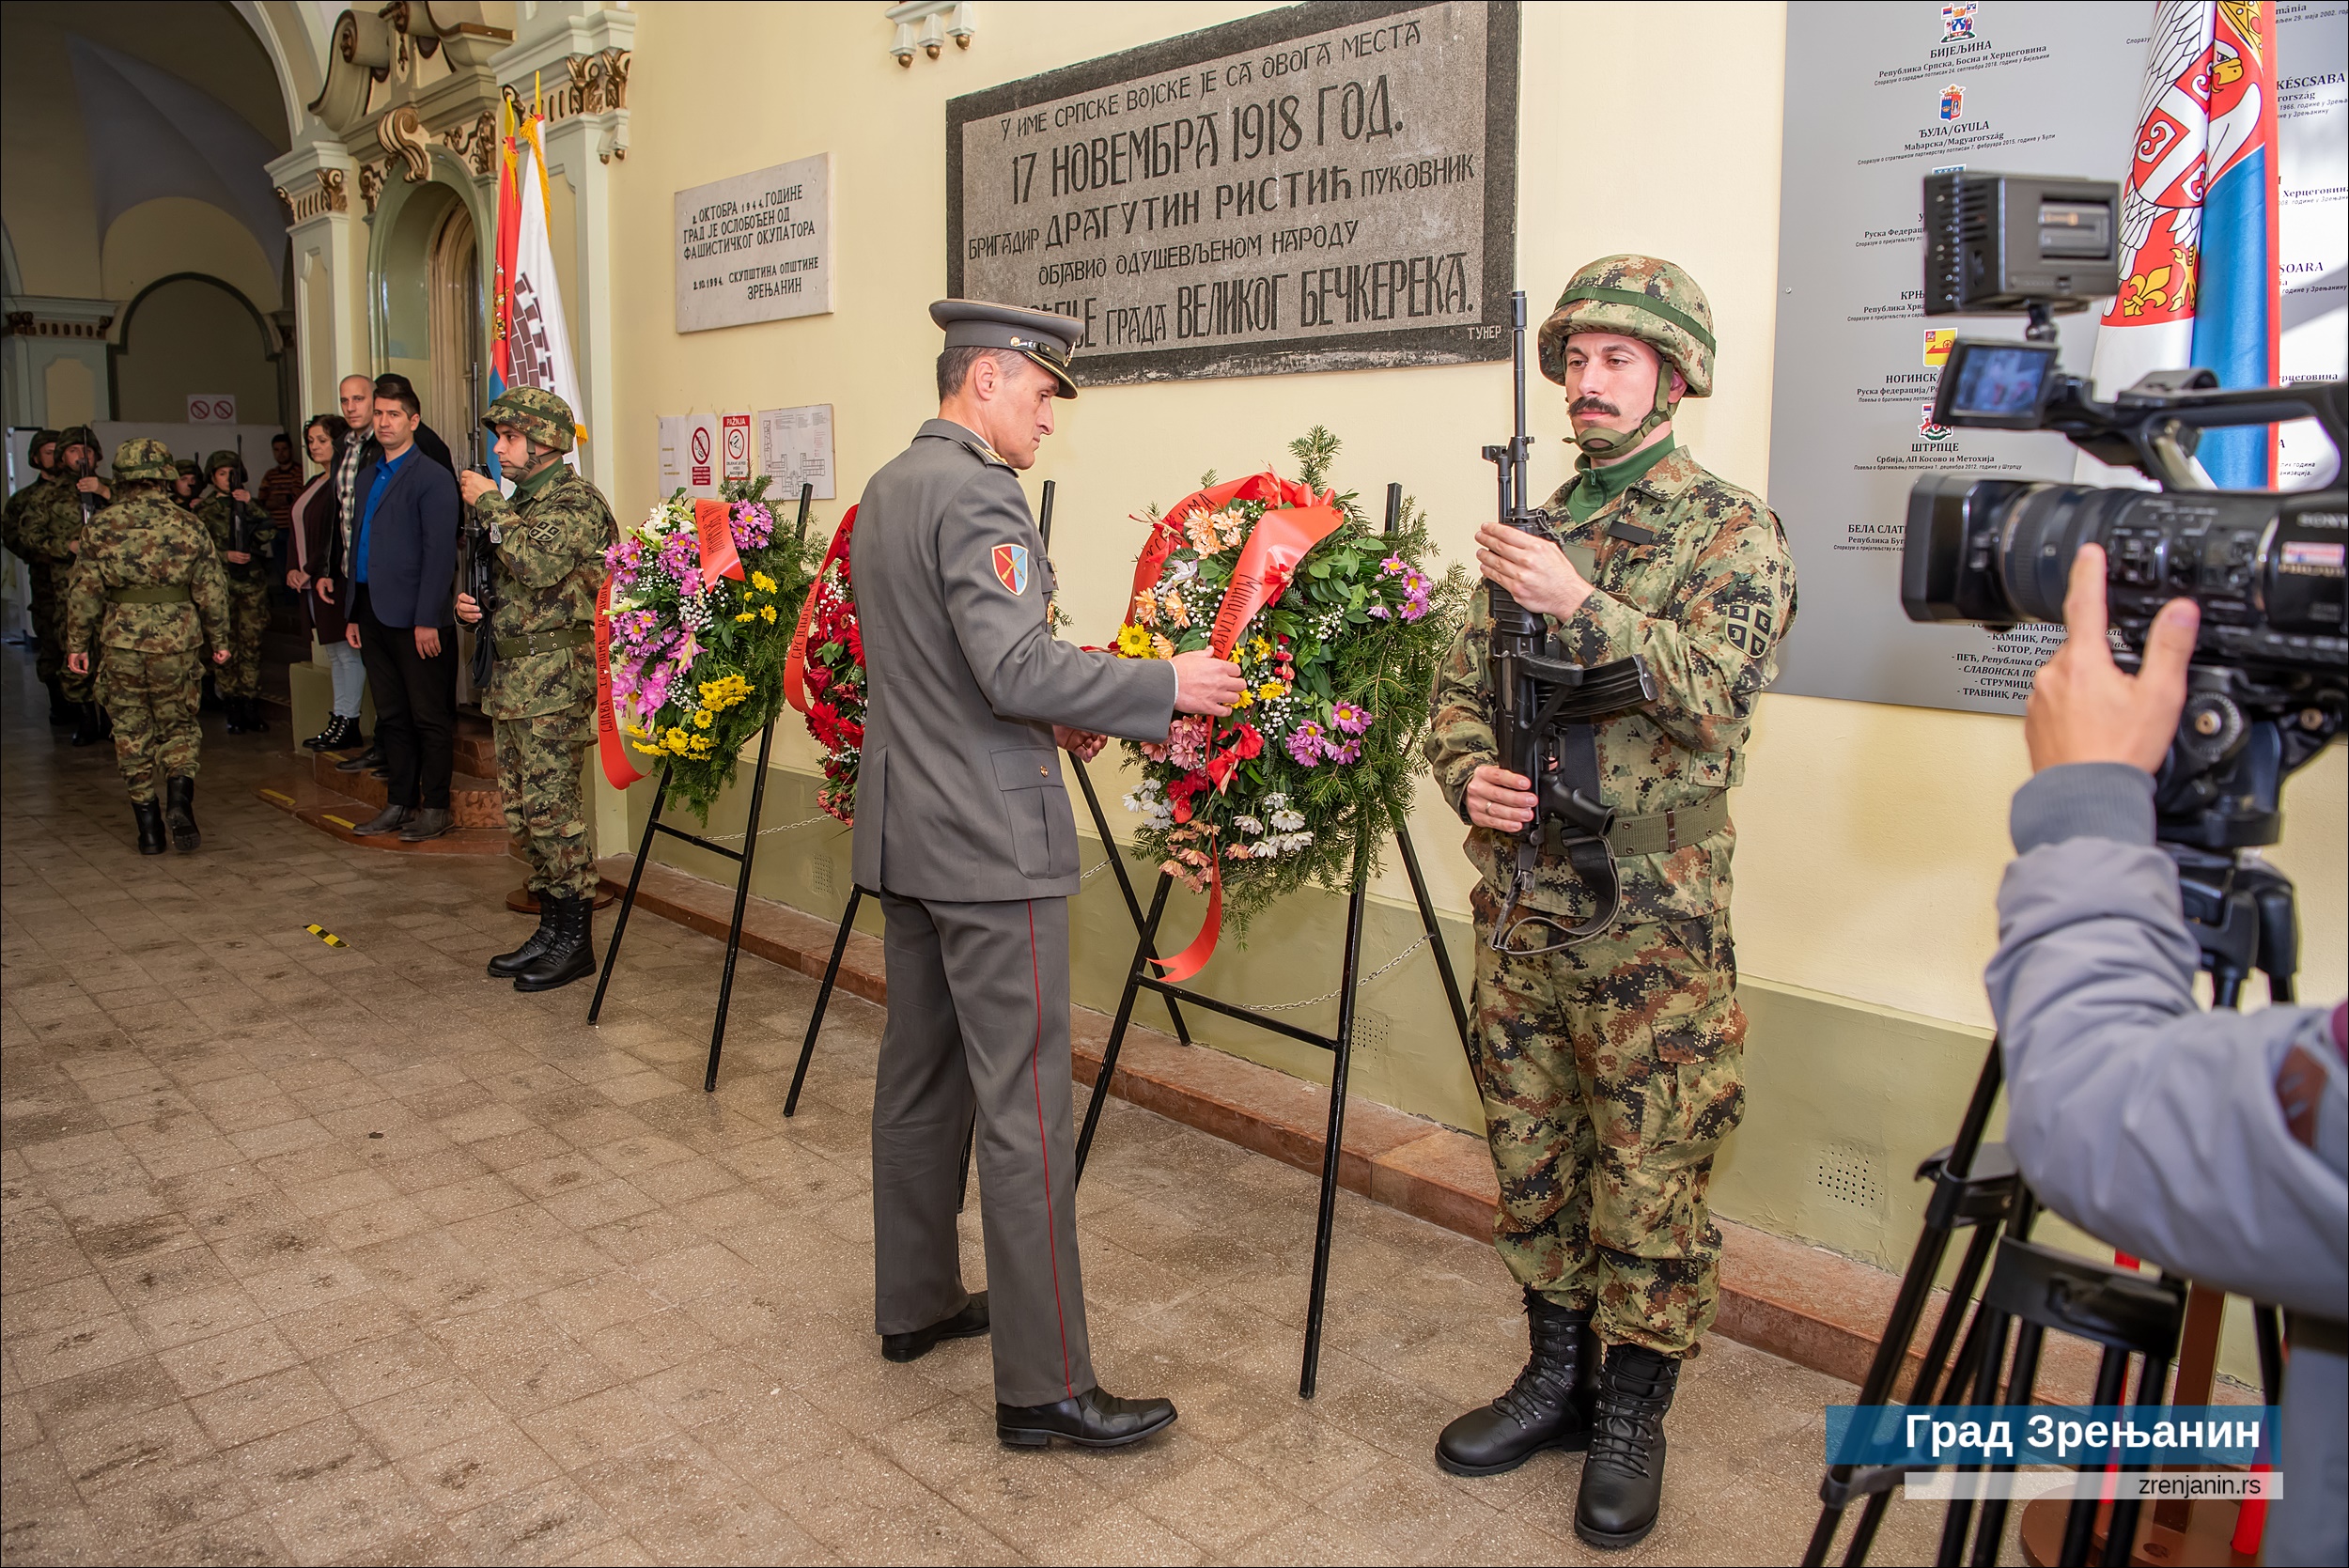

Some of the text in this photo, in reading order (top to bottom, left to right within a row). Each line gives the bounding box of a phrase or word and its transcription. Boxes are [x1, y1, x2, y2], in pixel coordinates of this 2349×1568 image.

[1930, 40, 1992, 58] БИЈЕЉИНА
[1874, 77, 1897, 86] Споразум
[1956, 63, 1984, 72] септембра
[2023, 54, 2050, 63] Бијељини
[1879, 66, 1921, 78] Република
[1923, 60, 1954, 71] Српска,
[1955, 55, 1981, 66] Босна
[1990, 45, 2046, 61] Херцеговина
[1001, 20, 1422, 143] У ИМЕ СРПСКЕ ВОЈСКЕ ЈЕ СА ОВОГА МЕСТА
[2293, 109, 2329, 118] Зрењанину
[1919, 120, 1990, 138] ЂУЛА/GYULA
[1012, 74, 1405, 206] 17 НОВЕМБРА 1918 ГОД.
[1904, 132, 2004, 151] Мађарска/Magyarország
[1885, 153, 1914, 162] стратешком
[1915, 149, 1945, 158] партнерству
[1976, 141, 2001, 150] фебруара
[699, 201, 739, 223] ОКТОБРА
[765, 184, 802, 208] ГОДИНЕ
[968, 152, 1475, 262] БРИГАДИР ДРАГУТИН РИСТИЋ ПУКОВНИК
[683, 207, 791, 244] ГРАД ЈЕ ОСЛОБОЂЕН ОД
[684, 220, 816, 261] ФАШИСТИЧКОГ ОКУПАТОРА
[1038, 220, 1361, 288] ОБЈАВИО ОДУШЕВЉЕНОМ НАРОДУ
[729, 265, 777, 284] СКУПШТИНА
[780, 256, 819, 274] ОПШТИНЕ
[747, 276, 802, 301] ЗРЕЊАНИН
[1106, 303, 1167, 347] ГРАДА
[1177, 273, 1291, 341] ВЕЛИКОГ
[1300, 251, 1474, 329] БЕЧКЕРЕКА.
[1864, 304, 1906, 314] Република
[1468, 325, 1501, 341] ТУНЕР
[726, 417, 746, 427] PAŽNJA
[1911, 443, 1959, 453] ШТРПЦЕ
[1877, 456, 1905, 464] Србија,
[1956, 455, 1994, 463] Метохија
[1848, 524, 1875, 534] БЕЛА
[1848, 536, 1889, 545] Република
[1992, 633, 2039, 644] КАМНИК,
[1998, 644, 2032, 656] КОТОР,
[1956, 654, 2032, 665] ПЕЋ, Република
[1964, 665, 2020, 676] СЛАВОНСКА
[1963, 688, 2009, 699] ТРАВНИК,
[600, 698, 614, 734] СЛАВА
